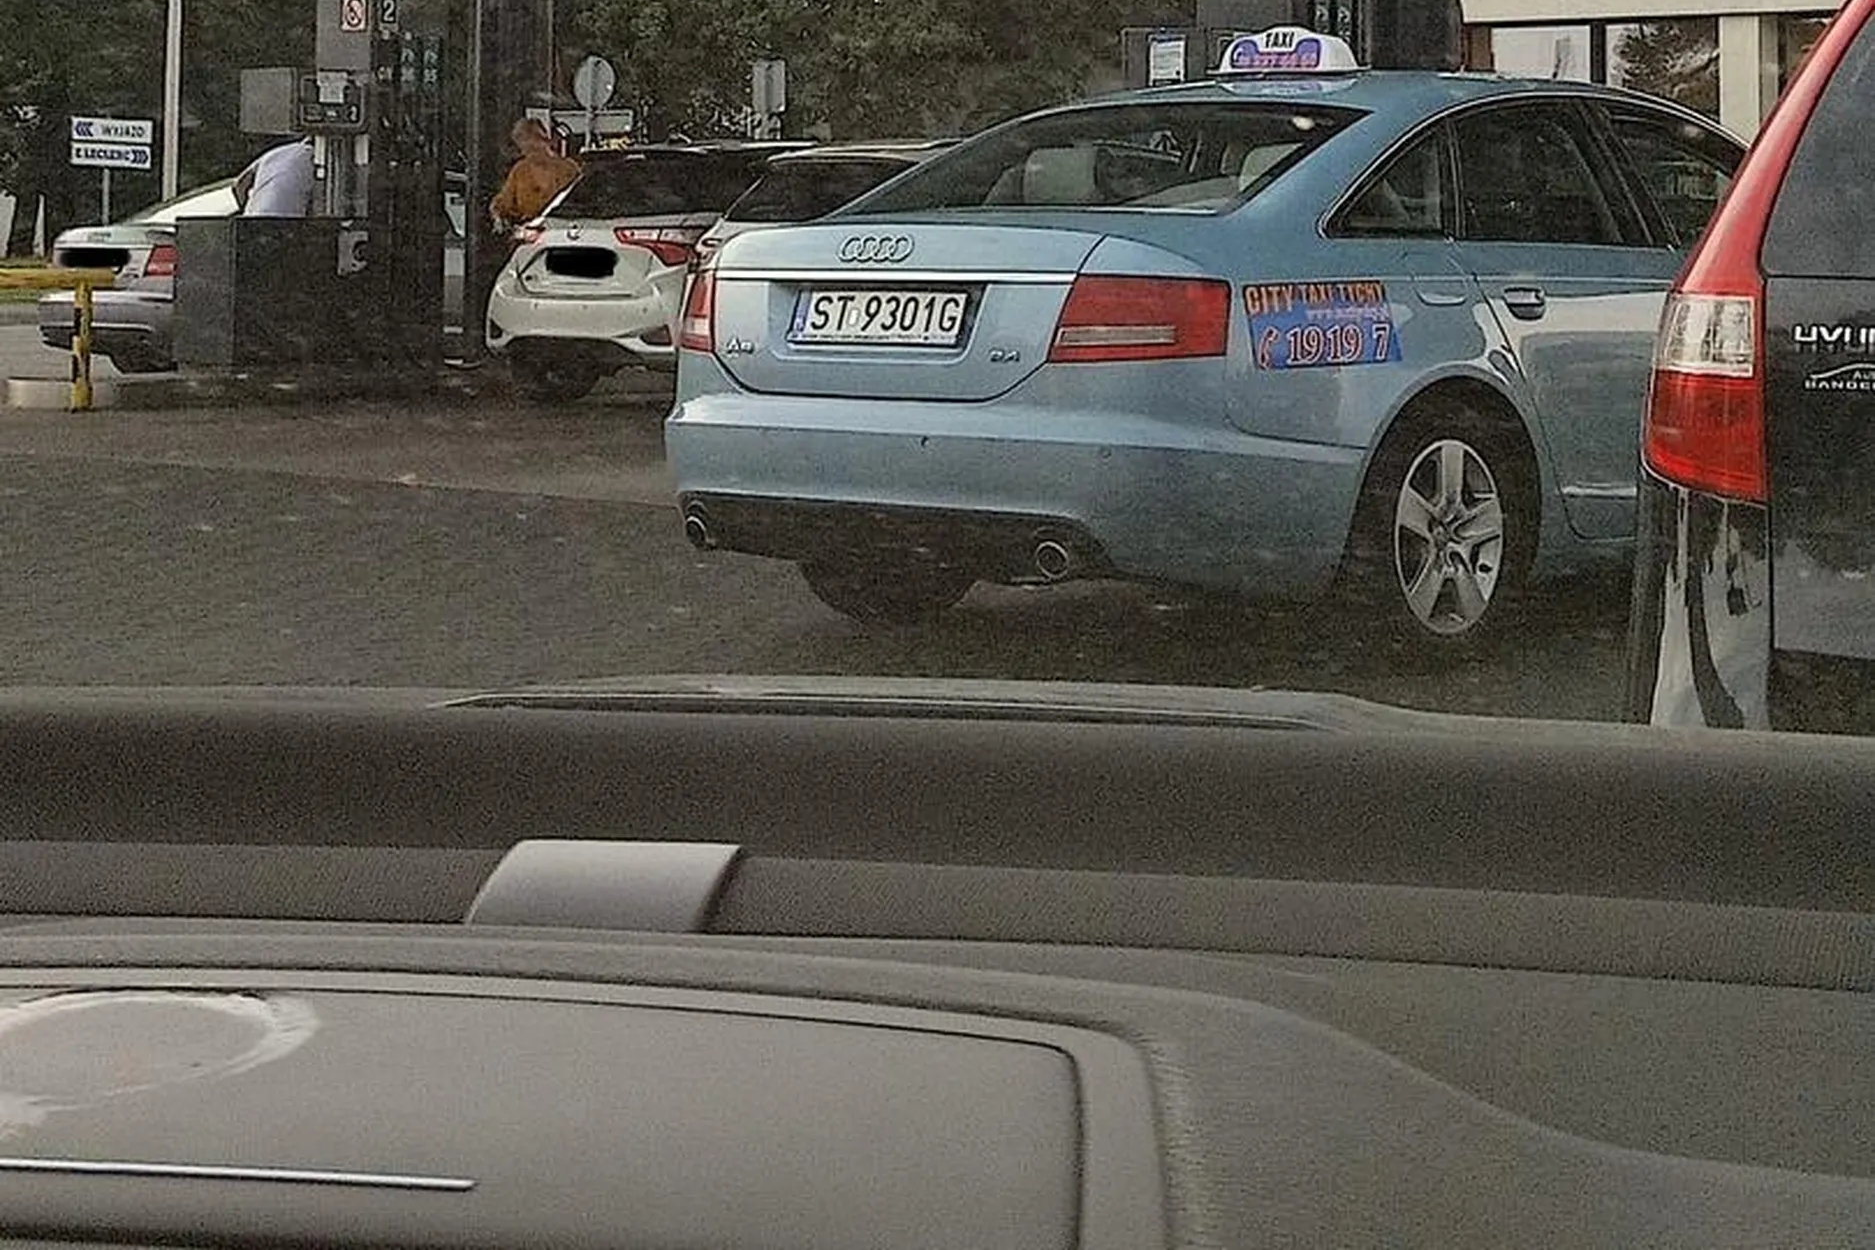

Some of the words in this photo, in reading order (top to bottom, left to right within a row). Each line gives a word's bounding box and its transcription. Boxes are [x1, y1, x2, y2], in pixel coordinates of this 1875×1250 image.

[383, 0, 395, 22] 2
[1265, 31, 1295, 49] TAXI
[1245, 285, 1293, 314] CITY
[1299, 283, 1333, 304] TAXI
[811, 296, 856, 331] ST
[861, 296, 960, 333] 9301G
[1804, 379, 1875, 390] HANDE
